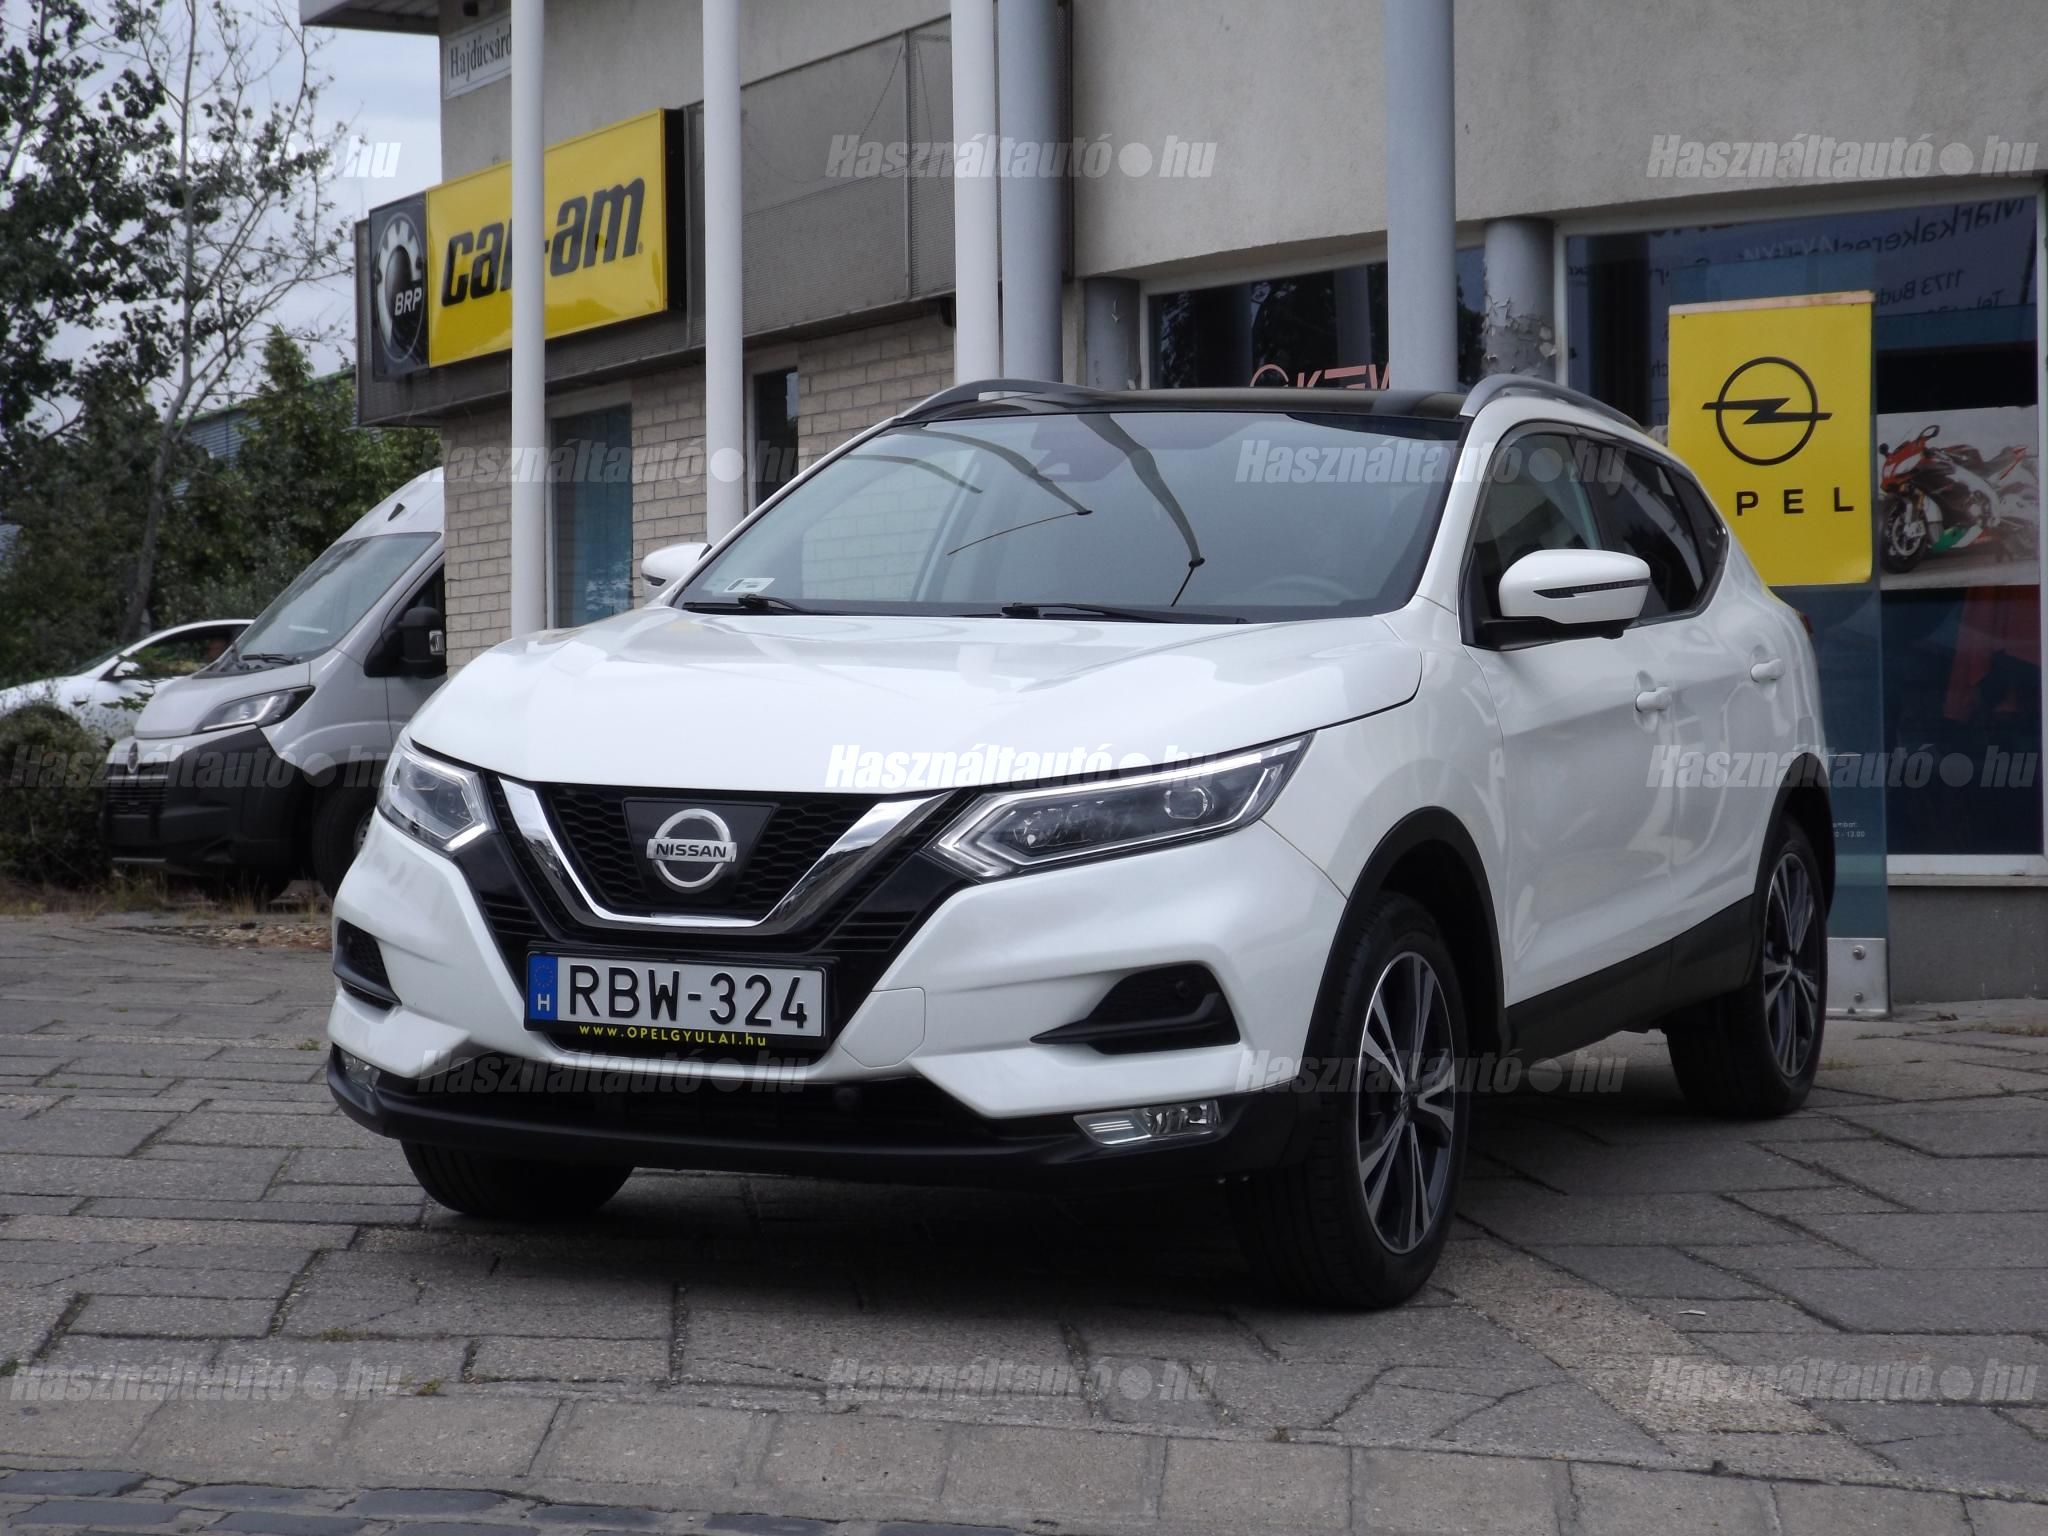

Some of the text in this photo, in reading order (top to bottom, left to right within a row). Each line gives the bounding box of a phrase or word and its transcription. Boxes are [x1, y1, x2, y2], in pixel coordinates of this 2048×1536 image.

[394, 286, 423, 317] BRP
[1736, 486, 1855, 517] PEL
[655, 843, 727, 859] NISSAN
[537, 964, 808, 1030] H RBW-324
[579, 1024, 767, 1047] www.OPELGYULAI.hu
